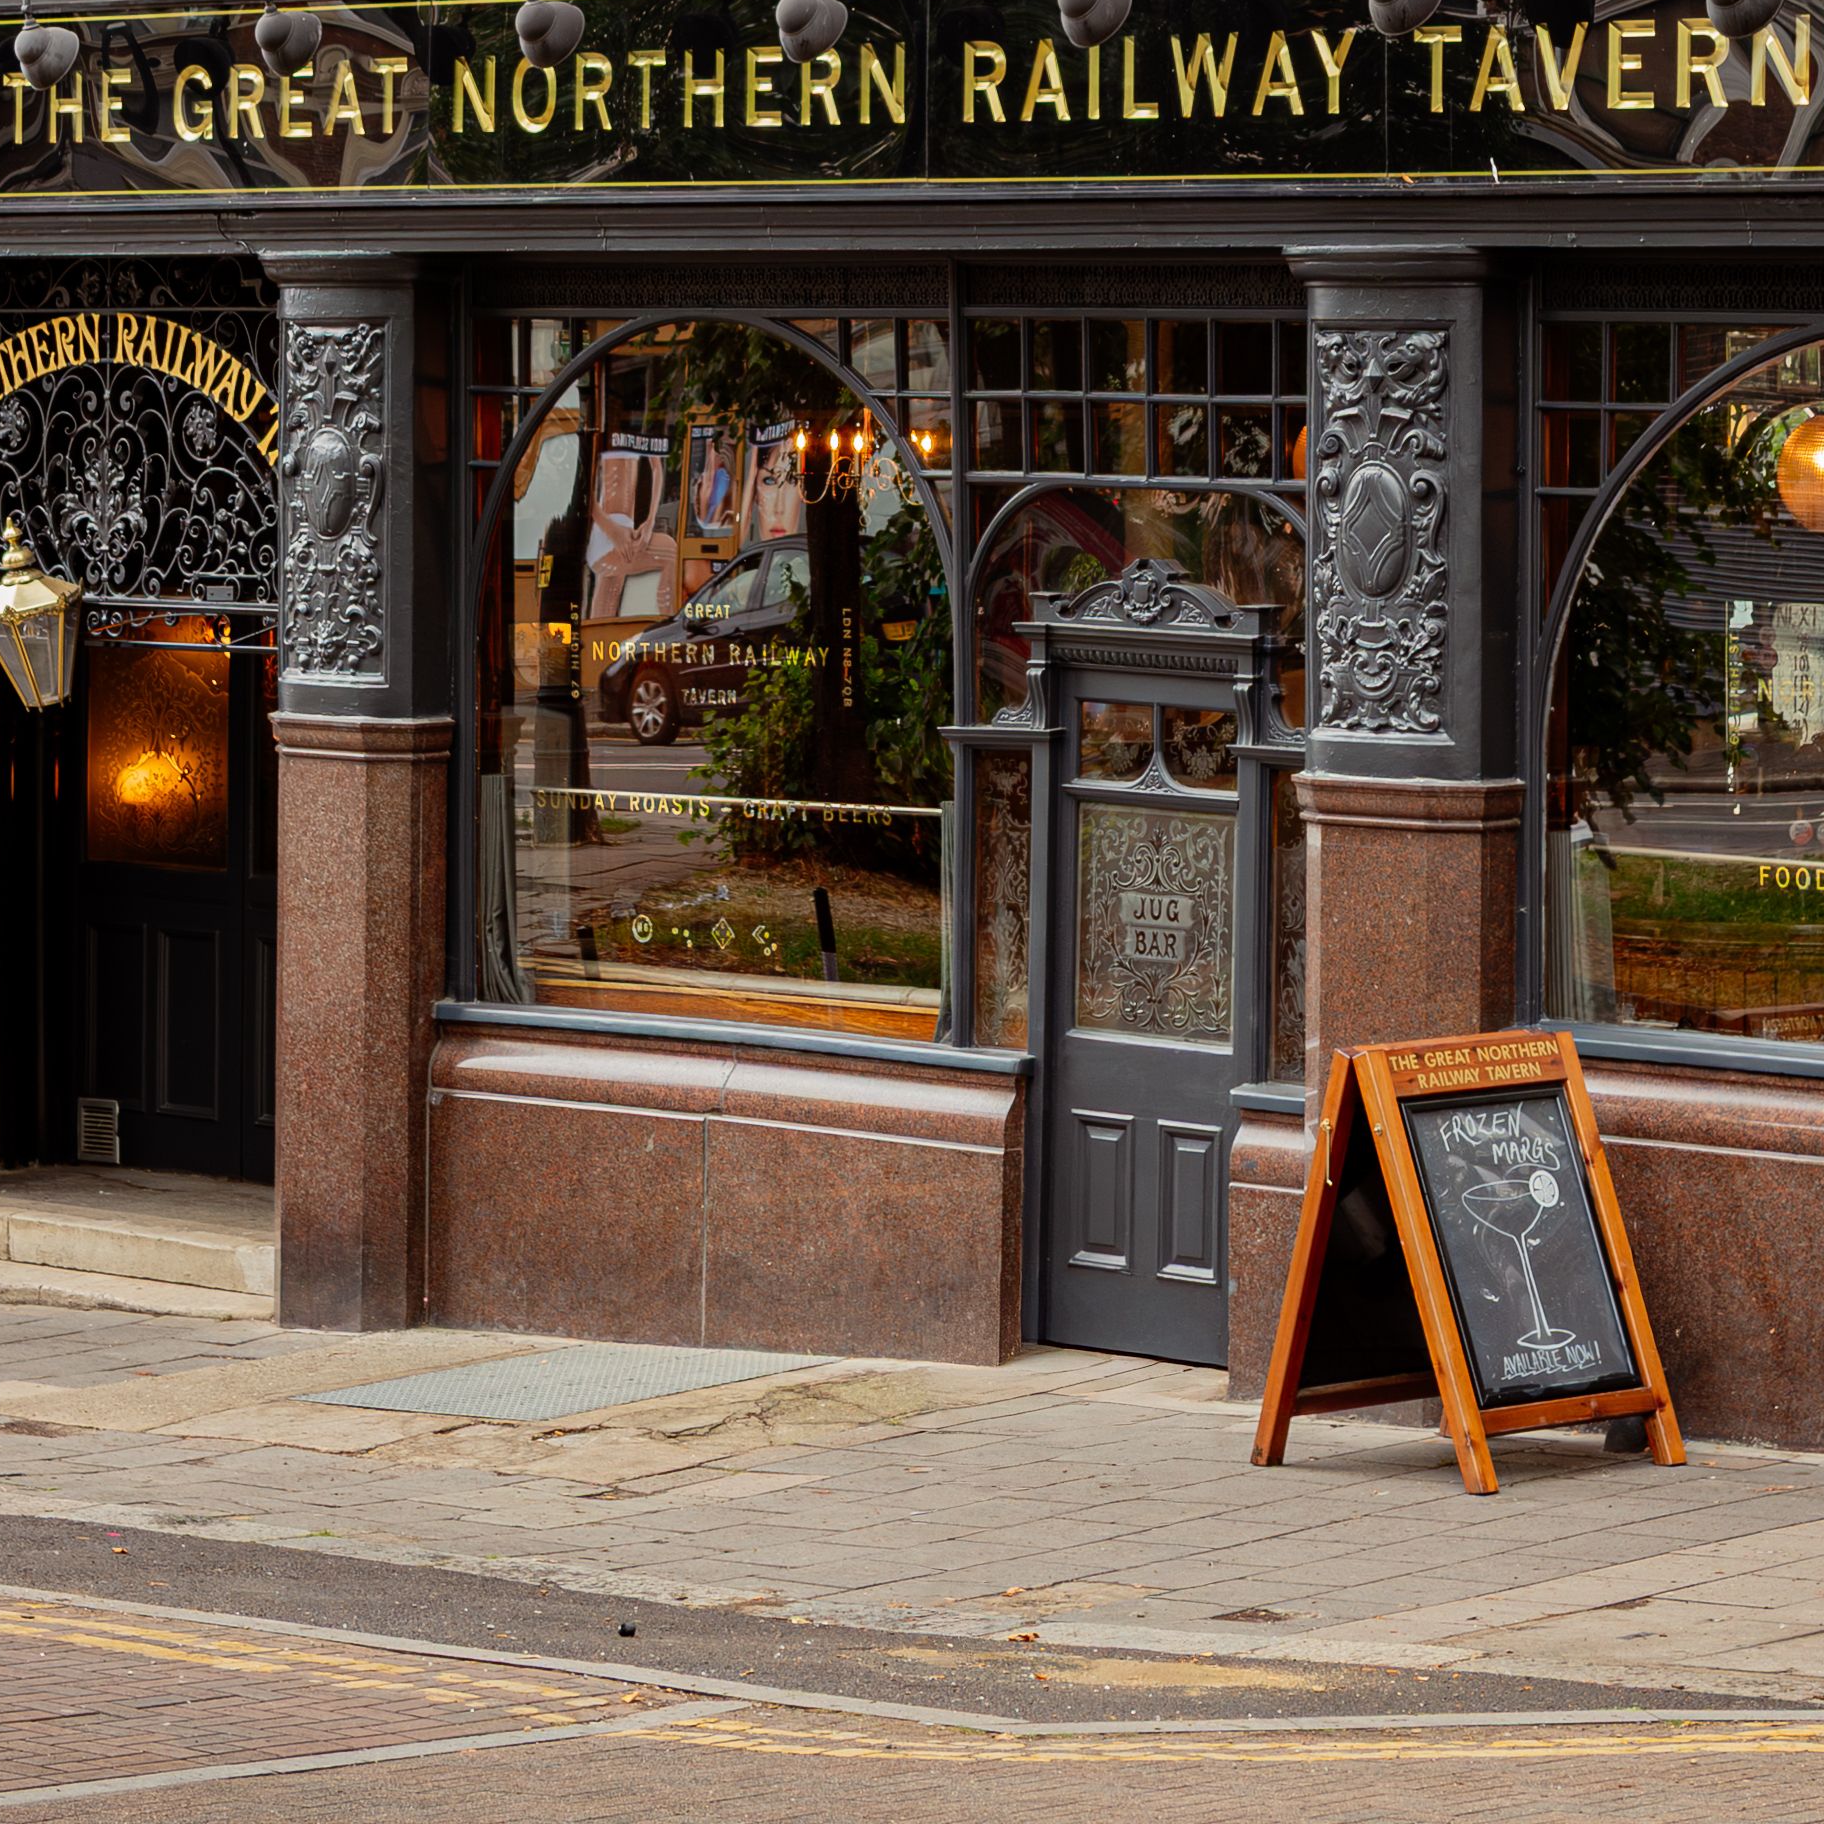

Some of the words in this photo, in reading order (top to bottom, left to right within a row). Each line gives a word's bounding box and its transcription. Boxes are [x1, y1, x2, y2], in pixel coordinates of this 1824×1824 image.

[2, 67, 132, 145] THE
[173, 56, 409, 143] GREAT
[453, 41, 906, 135] NORTHERN
[963, 27, 1357, 123] RAILWAY
[1413, 14, 1811, 114] TAVERN
[113, 312, 267, 423] RAILWAY
[570, 602, 579, 621] ST
[684, 602, 731, 619] GREAT
[842, 607, 852, 639] LDN
[570, 632, 580, 670] HIGH
[592, 641, 715, 665] NORTHERN
[728, 643, 830, 667] RAILWAY
[1729, 633, 1739, 654] ST
[570, 680, 580, 700] 67
[681, 688, 737, 705] TAVERN
[536, 789, 617, 811] SUNDAY
[628, 792, 710, 817] ROASTS
[743, 799, 809, 823] CRAFT
[823, 801, 892, 826] BEERS
[1133, 896, 1179, 923] JUG
[1134, 929, 1178, 959] BAR
[1389, 1054, 1419, 1072] THE
[1424, 1048, 1471, 1068] GREAT
[1476, 1039, 1559, 1064] NORTHERN
[1417, 1066, 1481, 1089] RAILWAY
[1485, 1062, 1542, 1081] TAVERN
[1439, 1101, 1523, 1152] FROZEN
[1492, 1136, 1561, 1172] MARGS
[1503, 1349, 1564, 1376] AVAILABLE
